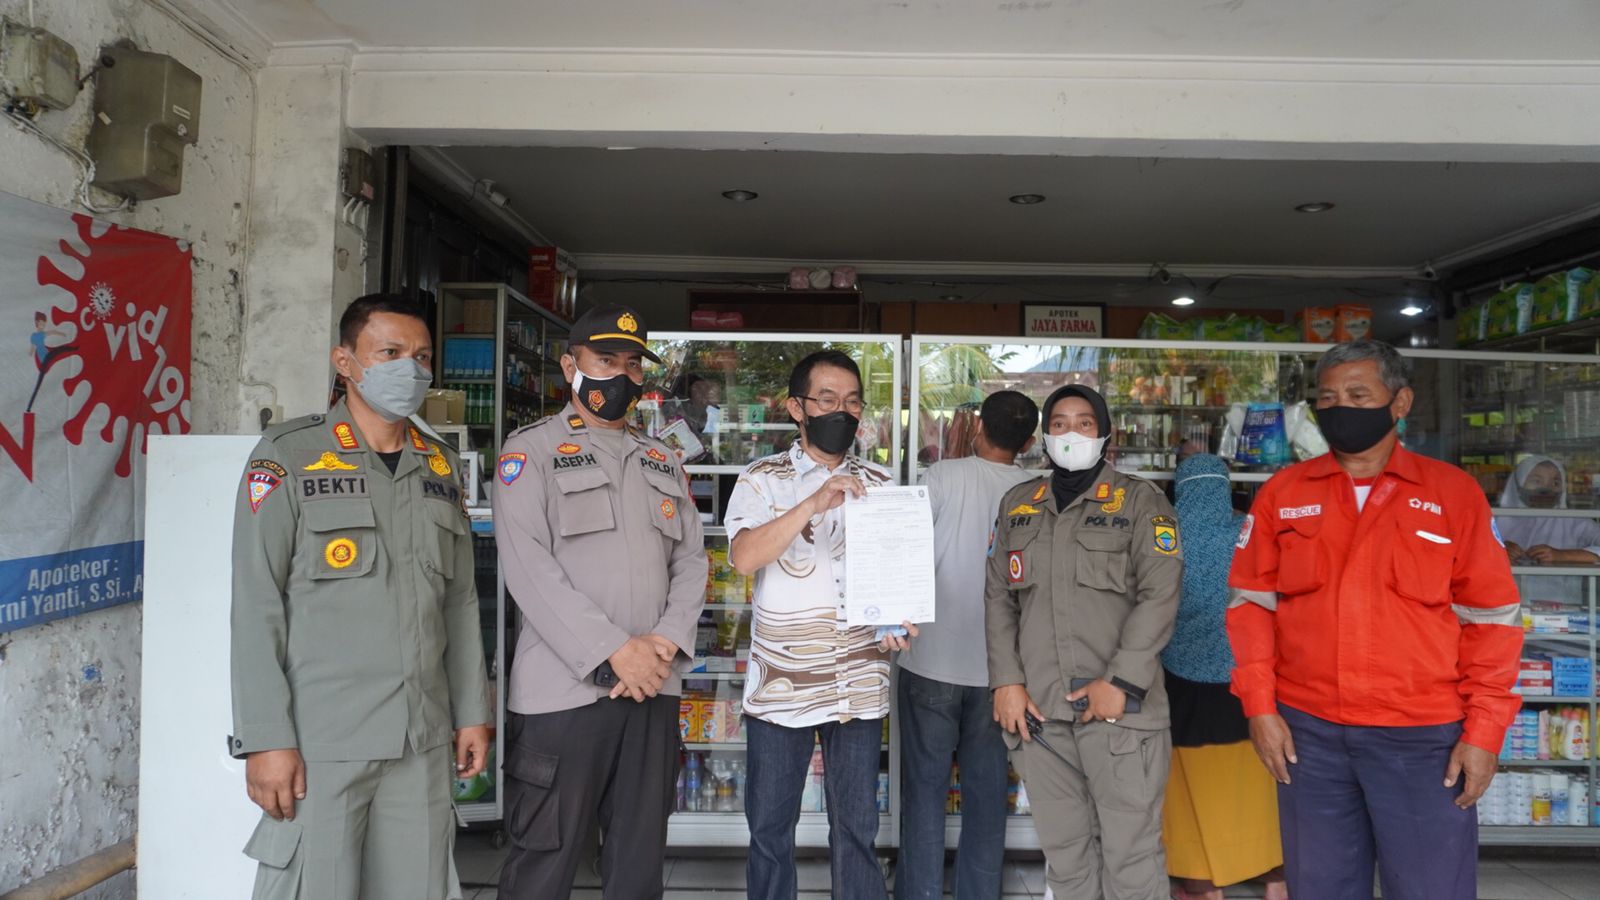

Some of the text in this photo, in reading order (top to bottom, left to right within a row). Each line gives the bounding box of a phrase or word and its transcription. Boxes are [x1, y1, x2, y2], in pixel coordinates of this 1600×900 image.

[1048, 309, 1079, 318] APOTEK
[1031, 319, 1097, 333] JAYA FARMA
[142, 345, 184, 414] 19
[553, 453, 597, 470] ASEP.H
[640, 457, 676, 478] POLRI
[253, 473, 271, 483] PTI
[302, 477, 366, 497] BEKTI
[422, 480, 447, 497] POL
[1282, 506, 1320, 518] RESCUE
[1009, 516, 1032, 529] SRI
[1084, 516, 1130, 529] POL PP
[27, 559, 111, 592] Apoteker
[32, 585, 86, 616] Yanti,
